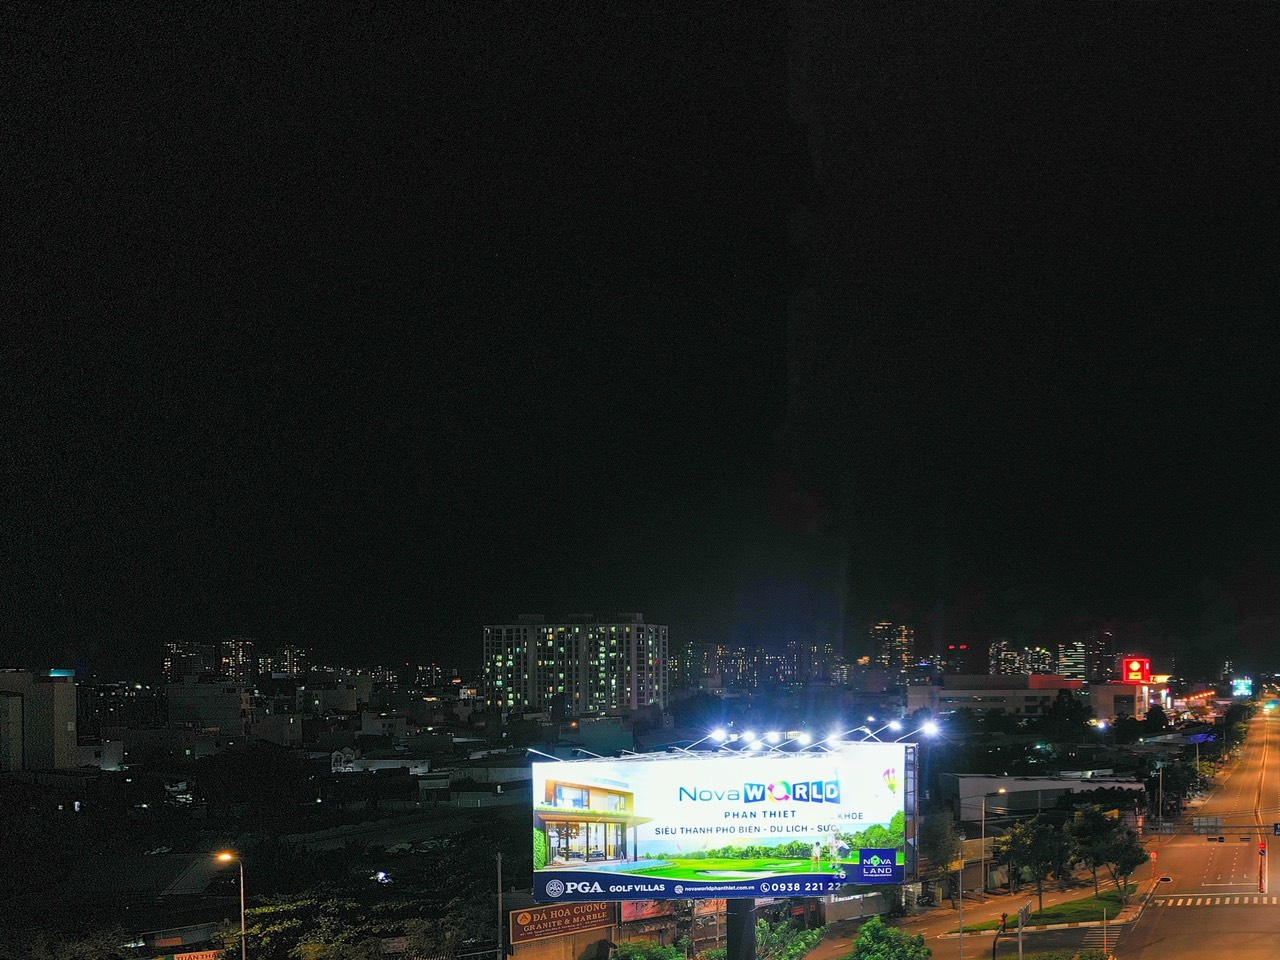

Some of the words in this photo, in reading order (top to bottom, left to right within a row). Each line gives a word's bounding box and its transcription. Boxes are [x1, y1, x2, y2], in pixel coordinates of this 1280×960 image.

[770, 825, 784, 833] DU
[565, 881, 604, 894] PGA
[609, 885, 633, 893] GOLF
[633, 884, 665, 892] VILLAS
[771, 882, 801, 892] 0938
[804, 882, 823, 891] 221
[523, 920, 563, 932] GRANITE
[572, 911, 608, 924] MARBLE
[533, 909, 548, 922] ĐÁ
[550, 909, 571, 919] HOA
